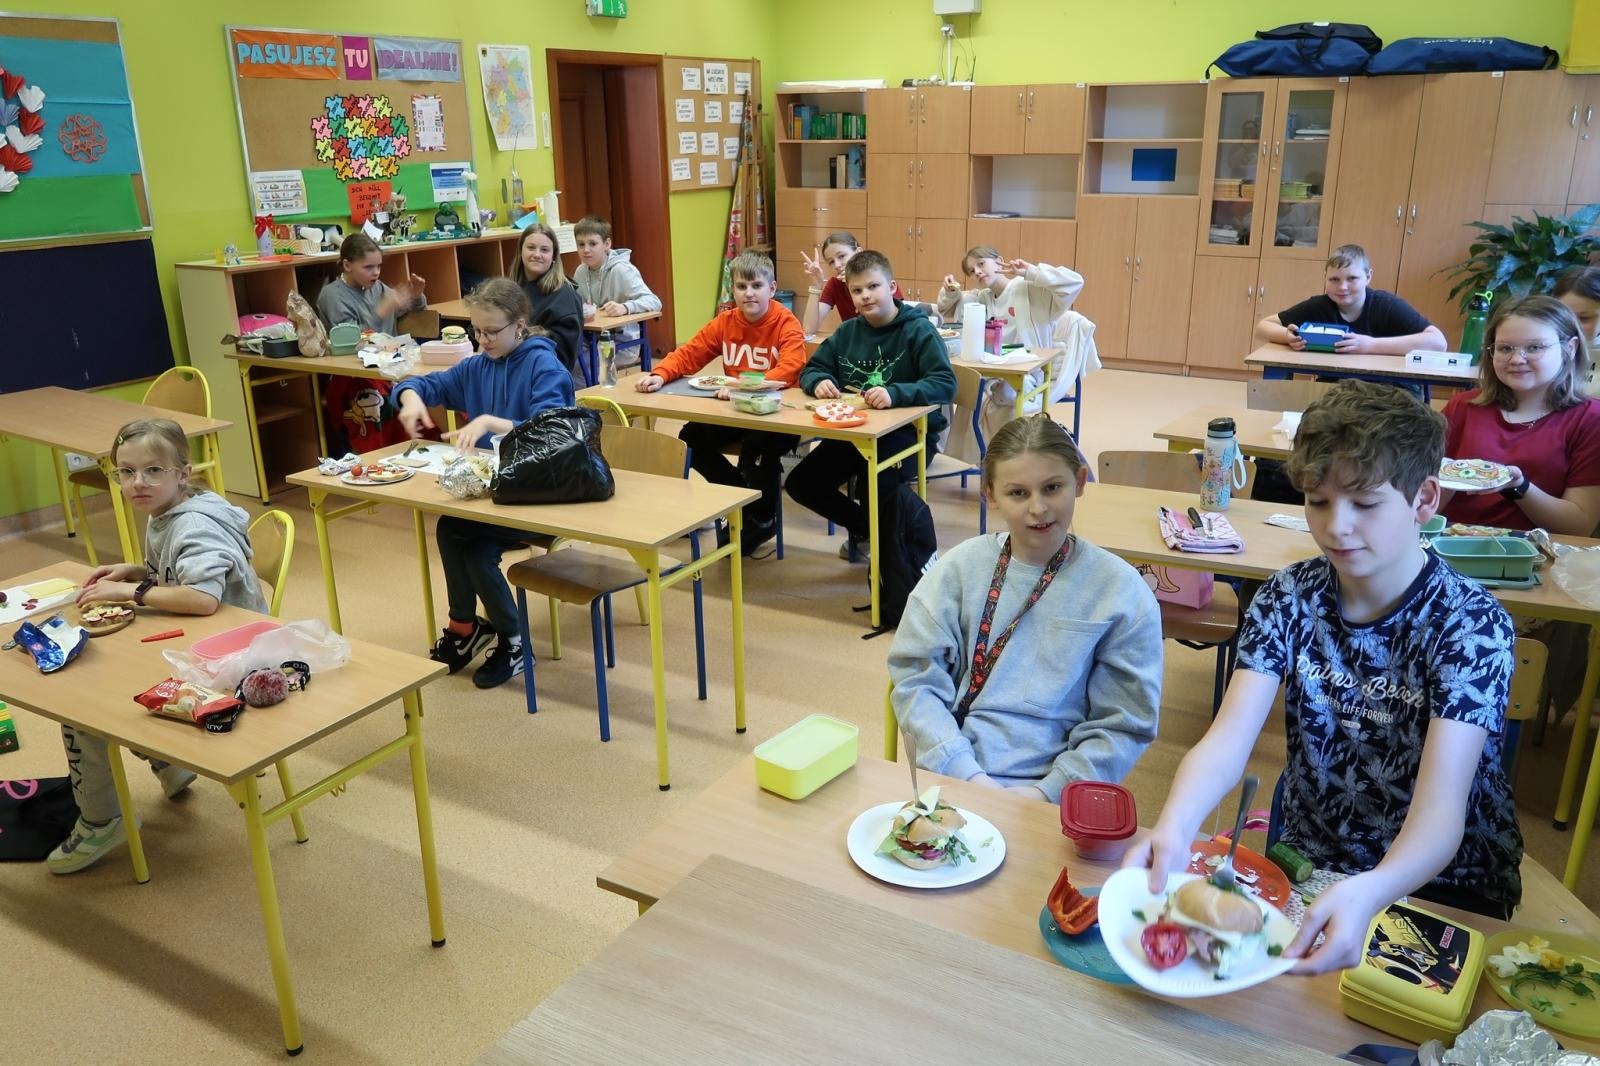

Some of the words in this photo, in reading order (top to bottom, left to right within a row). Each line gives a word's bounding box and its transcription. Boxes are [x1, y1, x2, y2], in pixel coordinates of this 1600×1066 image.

[237, 43, 337, 67] PASUJESZ
[344, 49, 368, 69] TU
[378, 49, 457, 73] IDEALNIE!
[1315, 694, 1342, 710] SURFER
[1342, 703, 1361, 715] LIFE
[1362, 676, 1425, 708] Beach
